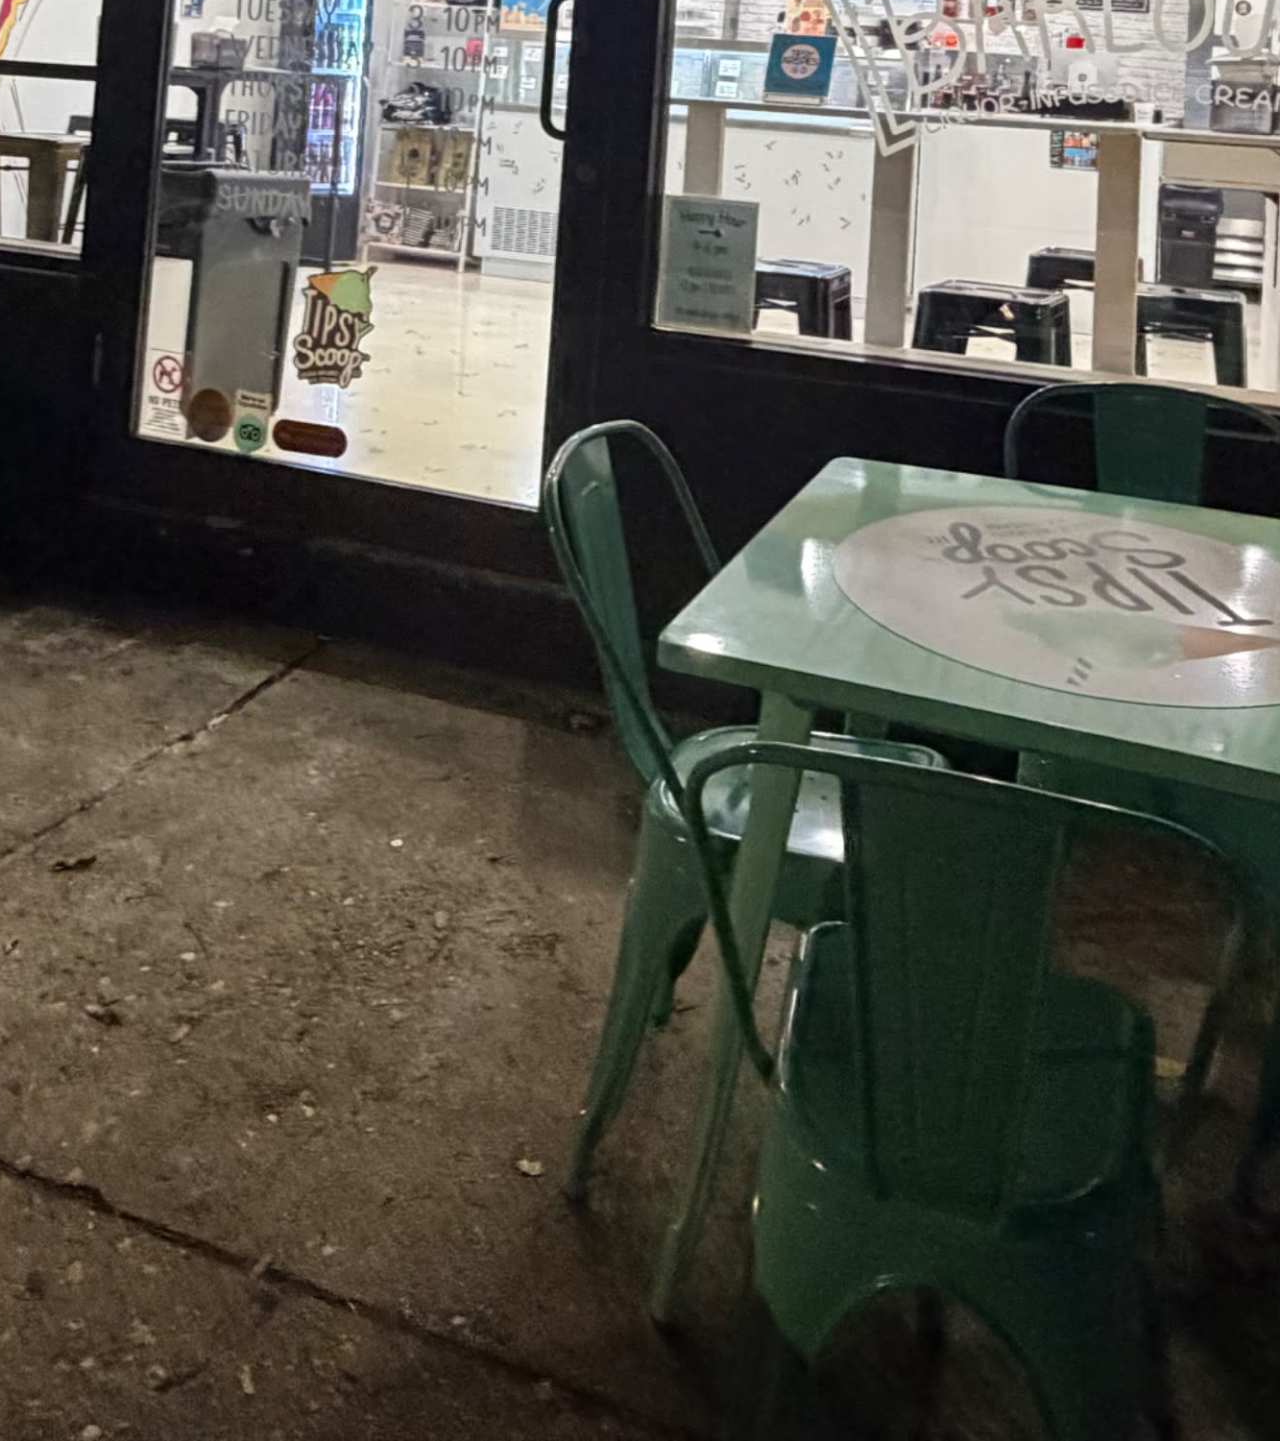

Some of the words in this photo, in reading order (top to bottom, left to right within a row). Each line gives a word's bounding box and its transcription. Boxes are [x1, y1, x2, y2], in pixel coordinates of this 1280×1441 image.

[303, 289, 374, 347] TIPSY
[294, 333, 362, 387] Scoop
[942, 521, 1186, 570] Scoop
[960, 560, 1276, 627] TIPSY
